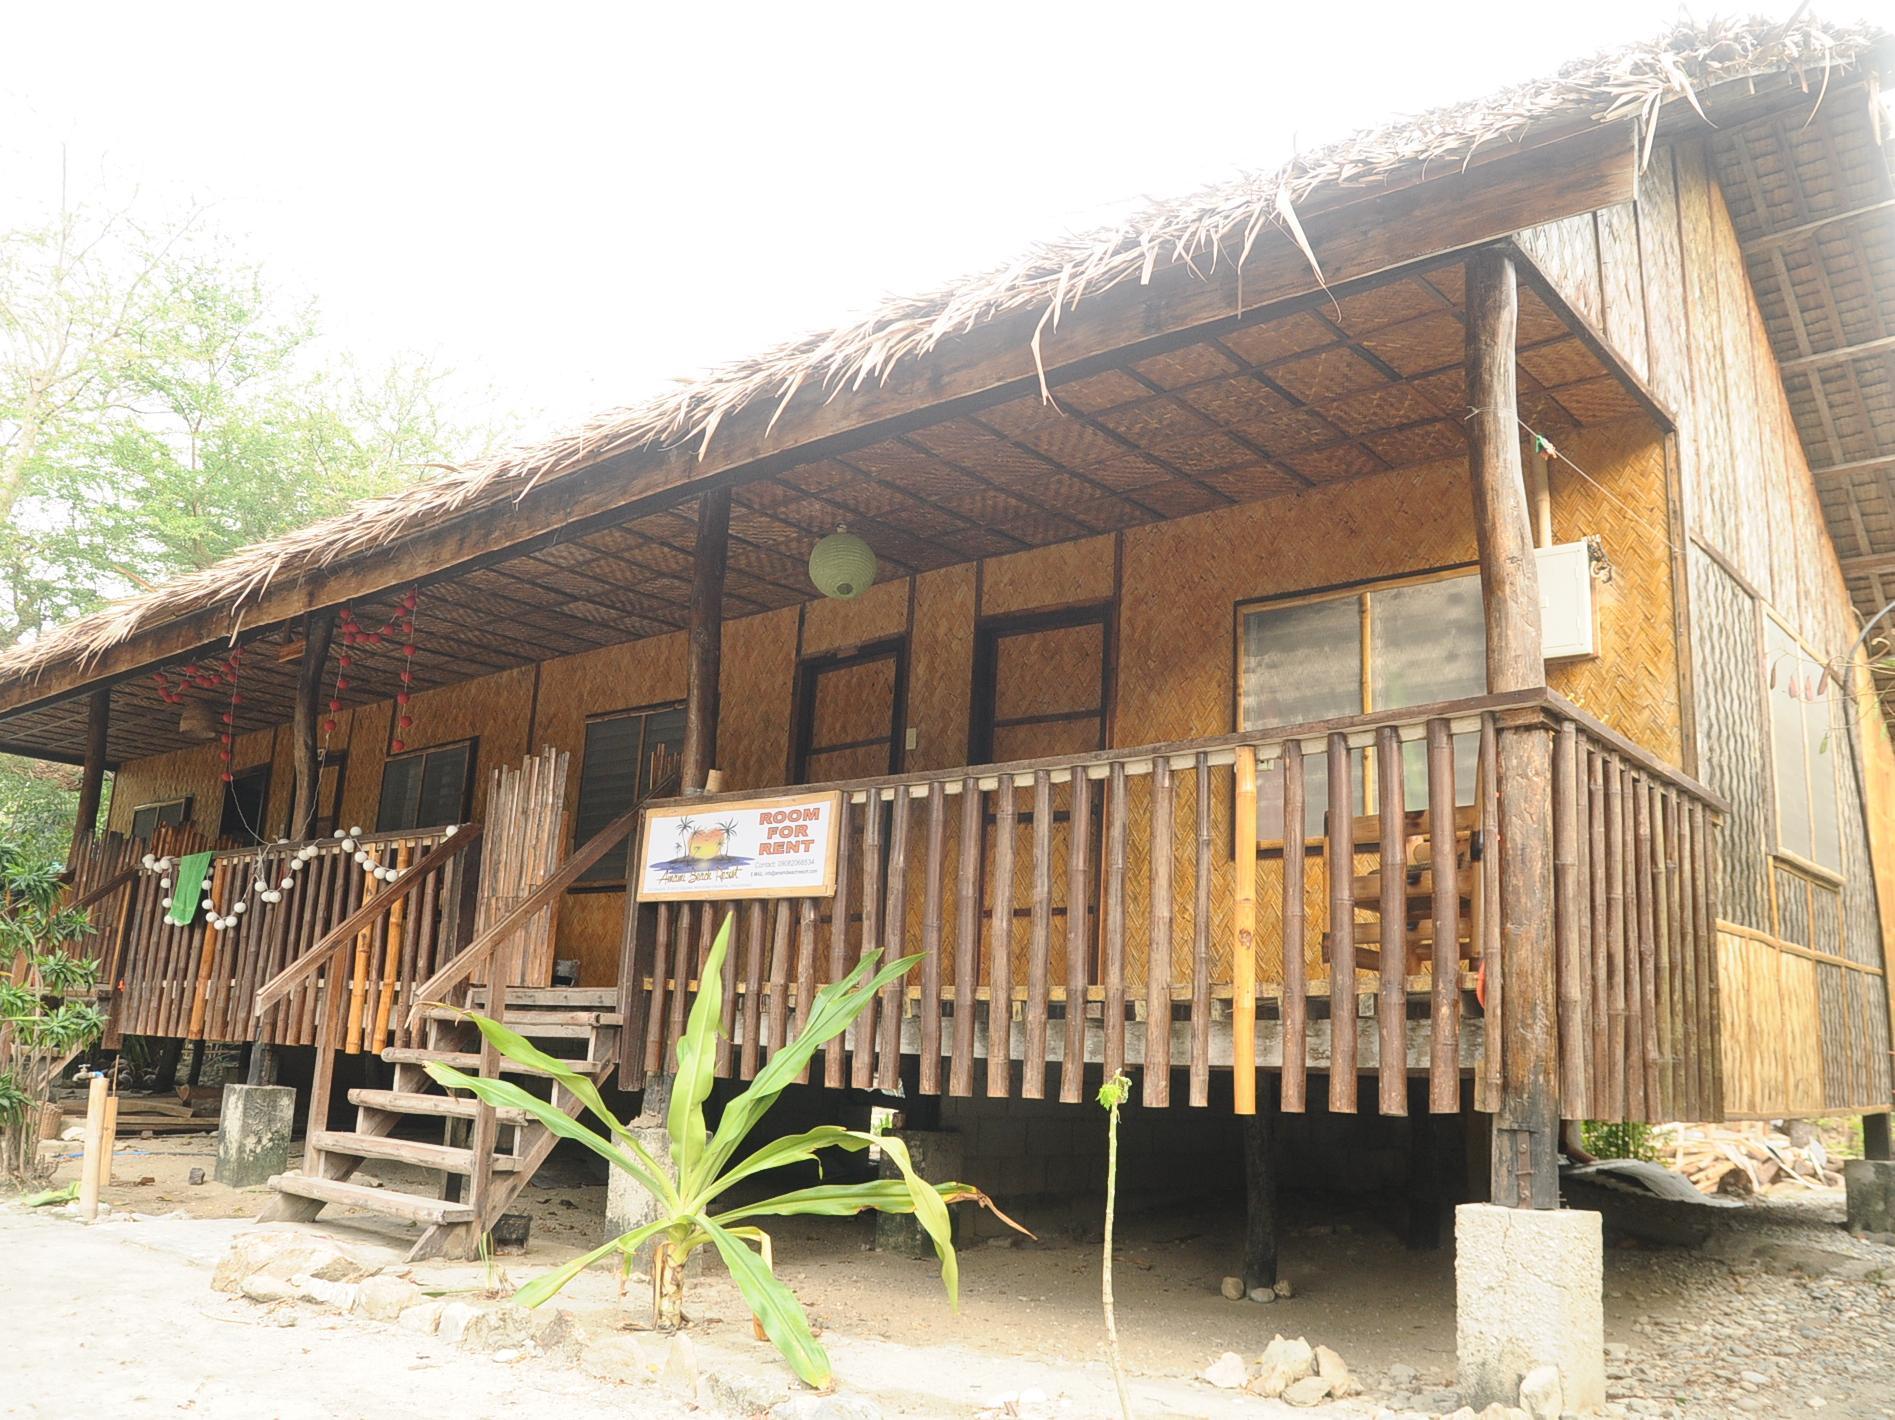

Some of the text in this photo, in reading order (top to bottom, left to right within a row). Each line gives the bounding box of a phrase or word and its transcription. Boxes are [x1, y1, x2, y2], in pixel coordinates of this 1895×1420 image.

[759, 808, 820, 825] ROOM
[767, 824, 809, 839] FOR
[758, 839, 815, 856] RENT
[688, 867, 713, 883] Beach
[716, 866, 743, 882] Resort
